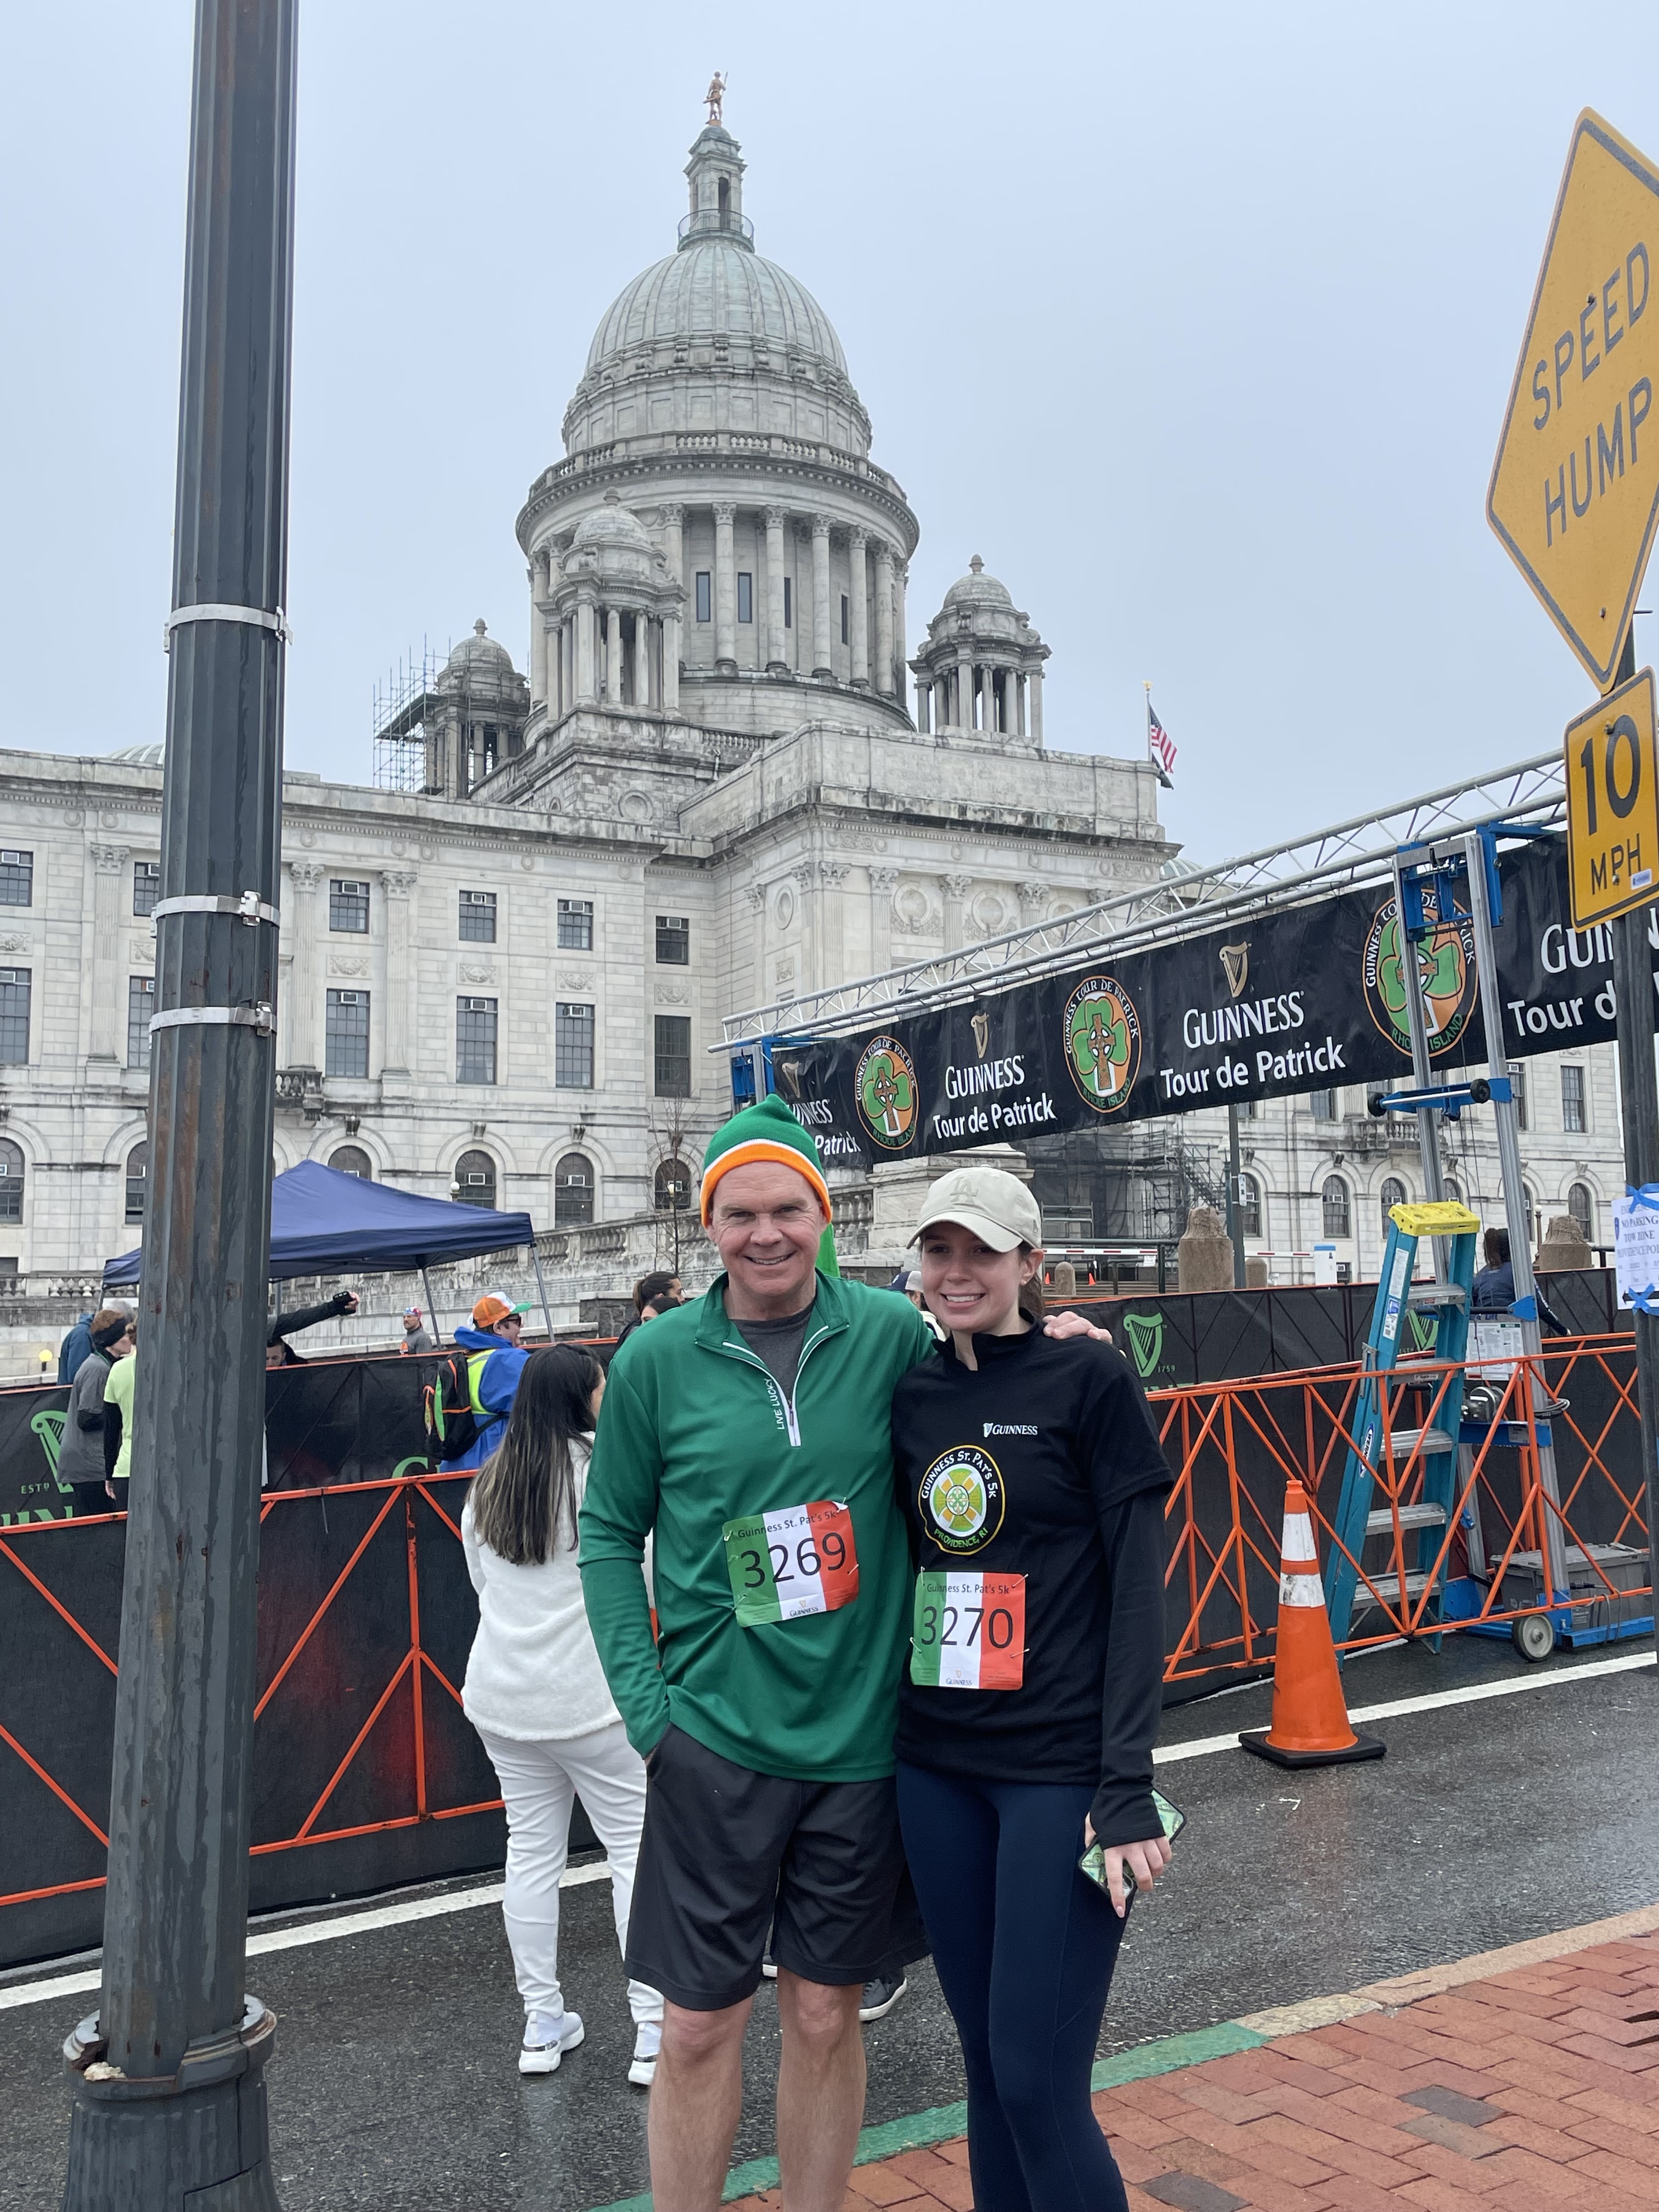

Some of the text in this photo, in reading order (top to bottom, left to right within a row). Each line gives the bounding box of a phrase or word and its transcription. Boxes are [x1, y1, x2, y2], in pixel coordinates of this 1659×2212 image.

[1533, 241, 1649, 431] SPEED
[1544, 376, 1652, 548] HUMP
[1581, 714, 1640, 836] 10
[1591, 833, 1642, 895] MPH
[1365, 922, 1382, 988] GUINNESS
[1065, 979, 1138, 1054] GUINNESS TOUR DE PATRICK
[1183, 991, 1305, 1049] GUINNESS
[1507, 979, 1617, 1037] Tour d
[1429, 1013, 1463, 1051] ISLAND
[856, 1056, 868, 1101] GUINNESS
[882, 1038, 892, 1050] DE
[945, 1055, 1025, 1099] GUINNESS
[1160, 1036, 1346, 1098] Tour de Patrick
[933, 1092, 1058, 1139] Tour de Patrick
[815, 1131, 862, 1156] Patrick
[1629, 1215, 1659, 1228] PARKING
[1637, 1230, 1655, 1241] ZONE
[1158, 1364, 1175, 1373] 1759
[764, 1378, 785, 1431] LIVE LUCKY
[992, 1424, 1038, 1435] GUINNESS
[921, 1454, 955, 1499] GUINNESS
[738, 1510, 836, 1538] Guinness St. Pat's 5k
[741, 1532, 846, 1588] 3269
[789, 1606, 819, 1617] GUINNESS
[927, 1583, 1009, 1595] Guinness St. Pat's 5k
[921, 1606, 1013, 1649] 3270
[946, 1678, 973, 1686] GUINNESS
